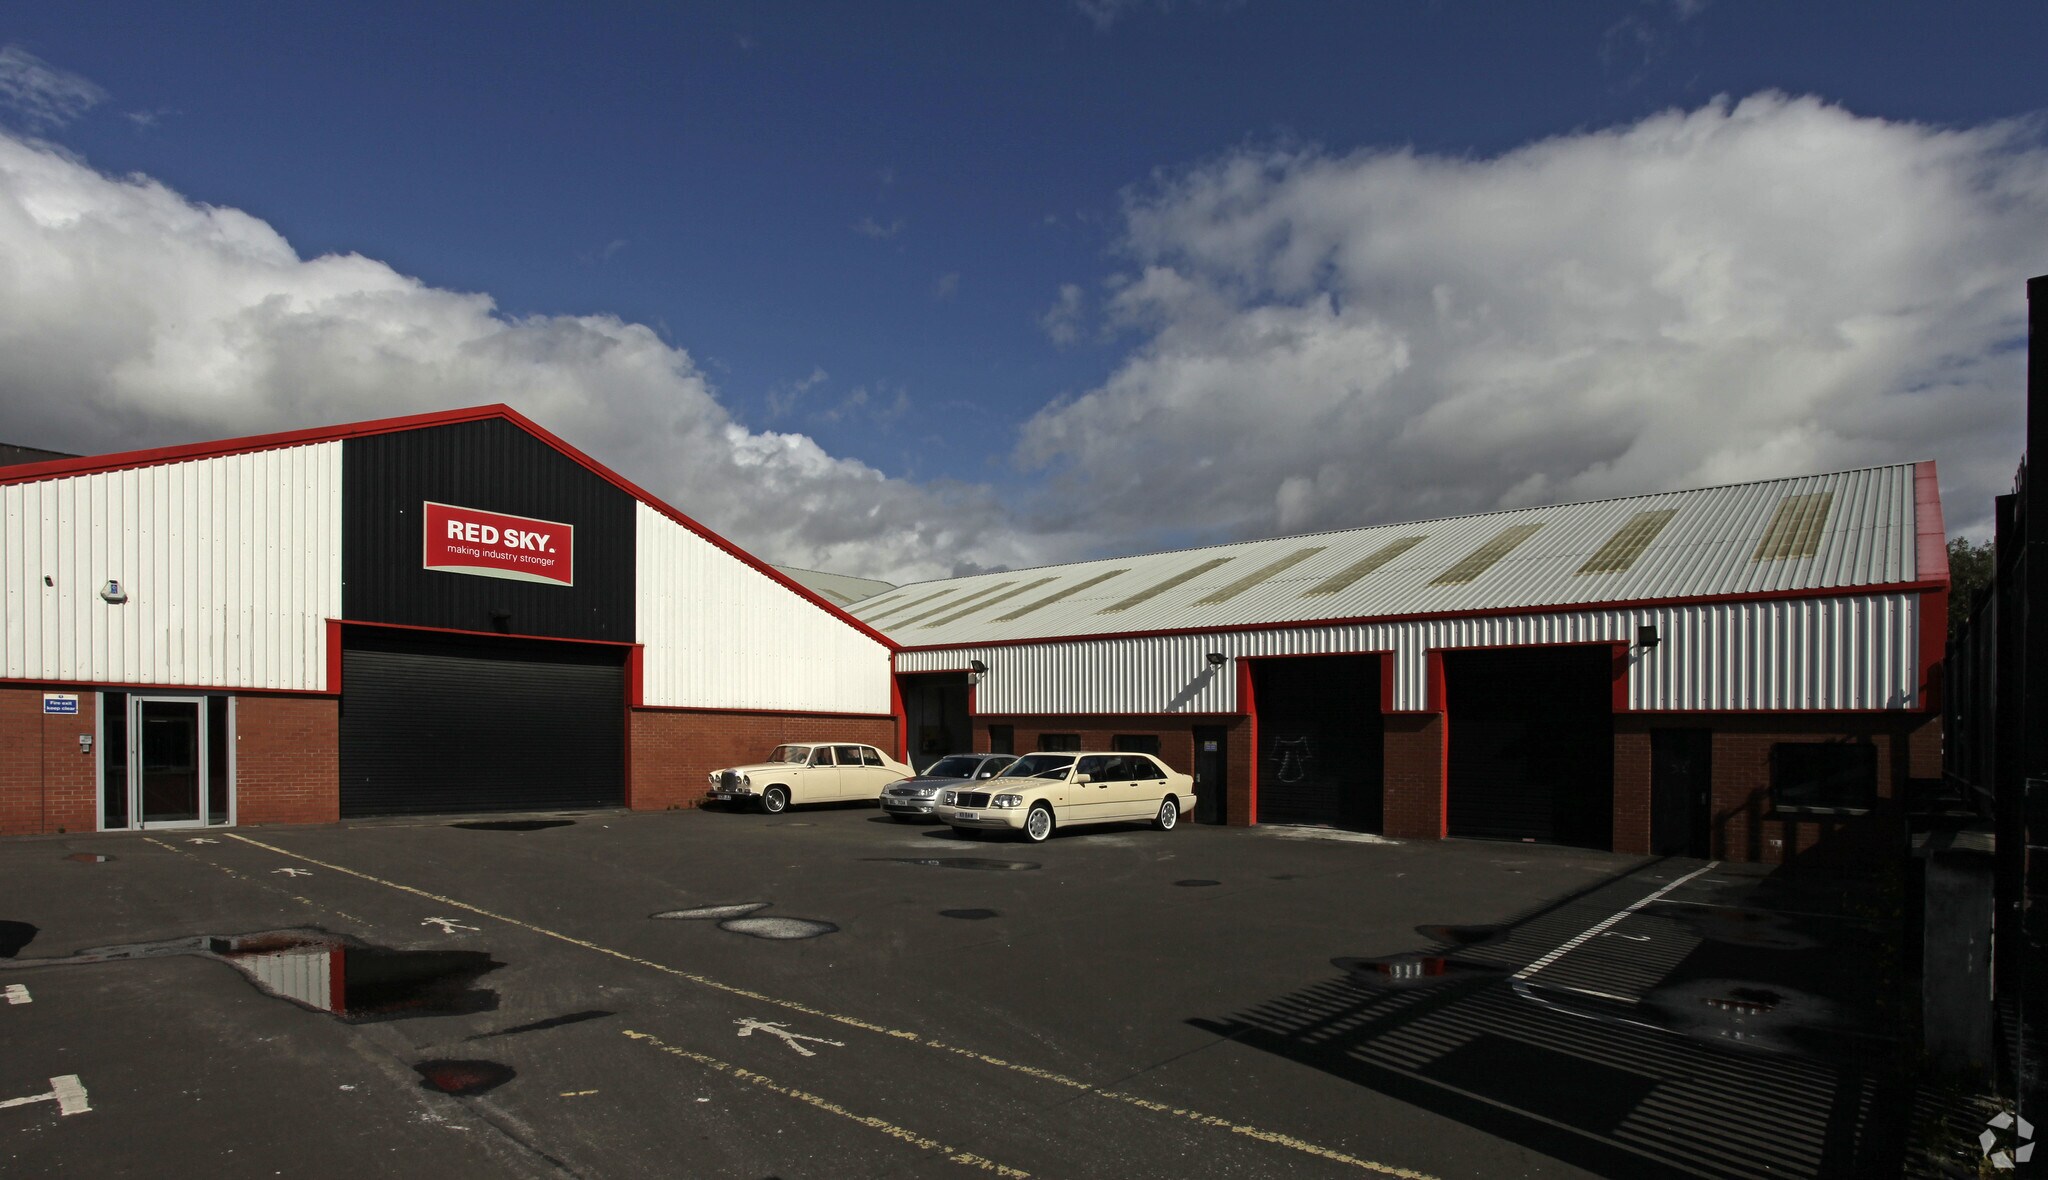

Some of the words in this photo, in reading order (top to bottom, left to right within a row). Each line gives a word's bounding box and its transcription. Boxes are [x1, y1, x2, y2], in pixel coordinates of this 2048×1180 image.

[447, 520, 499, 544] RED
[503, 528, 556, 553] SKY.
[447, 545, 480, 558] making
[482, 548, 518, 562] industry
[520, 554, 555, 566] stronger
